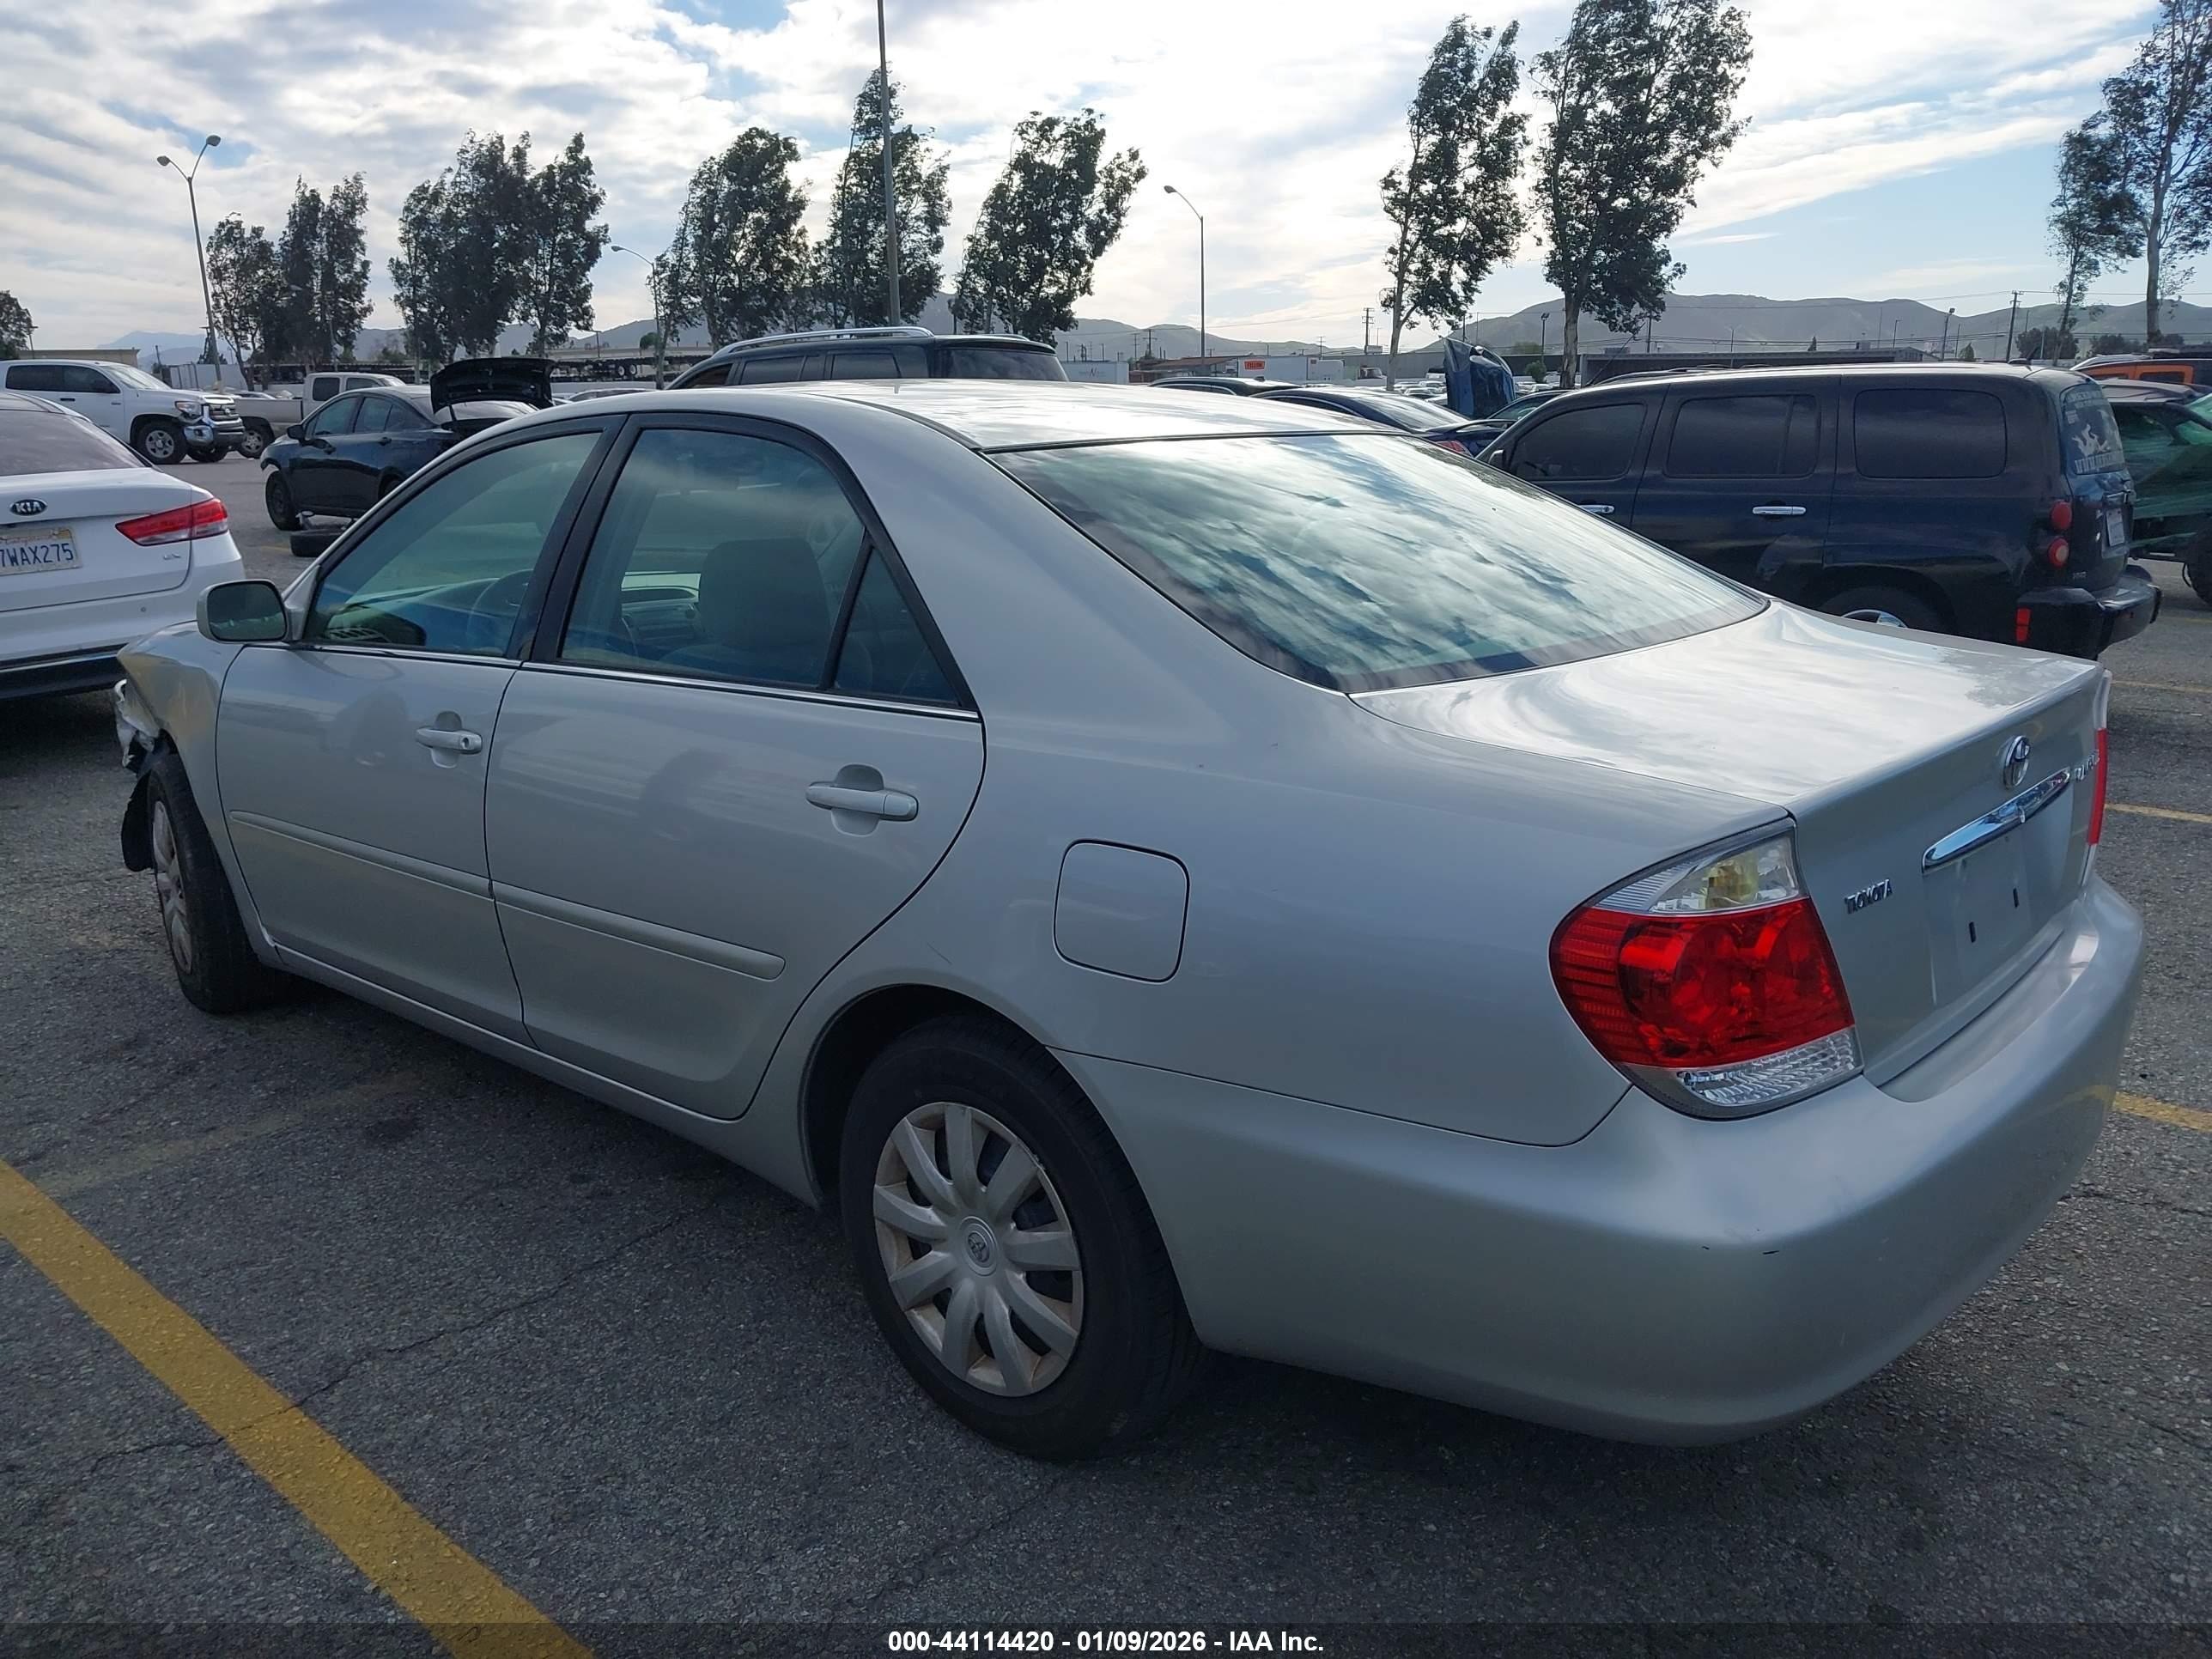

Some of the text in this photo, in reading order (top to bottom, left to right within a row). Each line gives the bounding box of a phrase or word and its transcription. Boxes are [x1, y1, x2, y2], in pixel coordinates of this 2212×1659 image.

[15, 501, 43, 514] KIA
[0, 542, 74, 568] 7WAX275
[1844, 878, 1893, 915] TOYOTA
